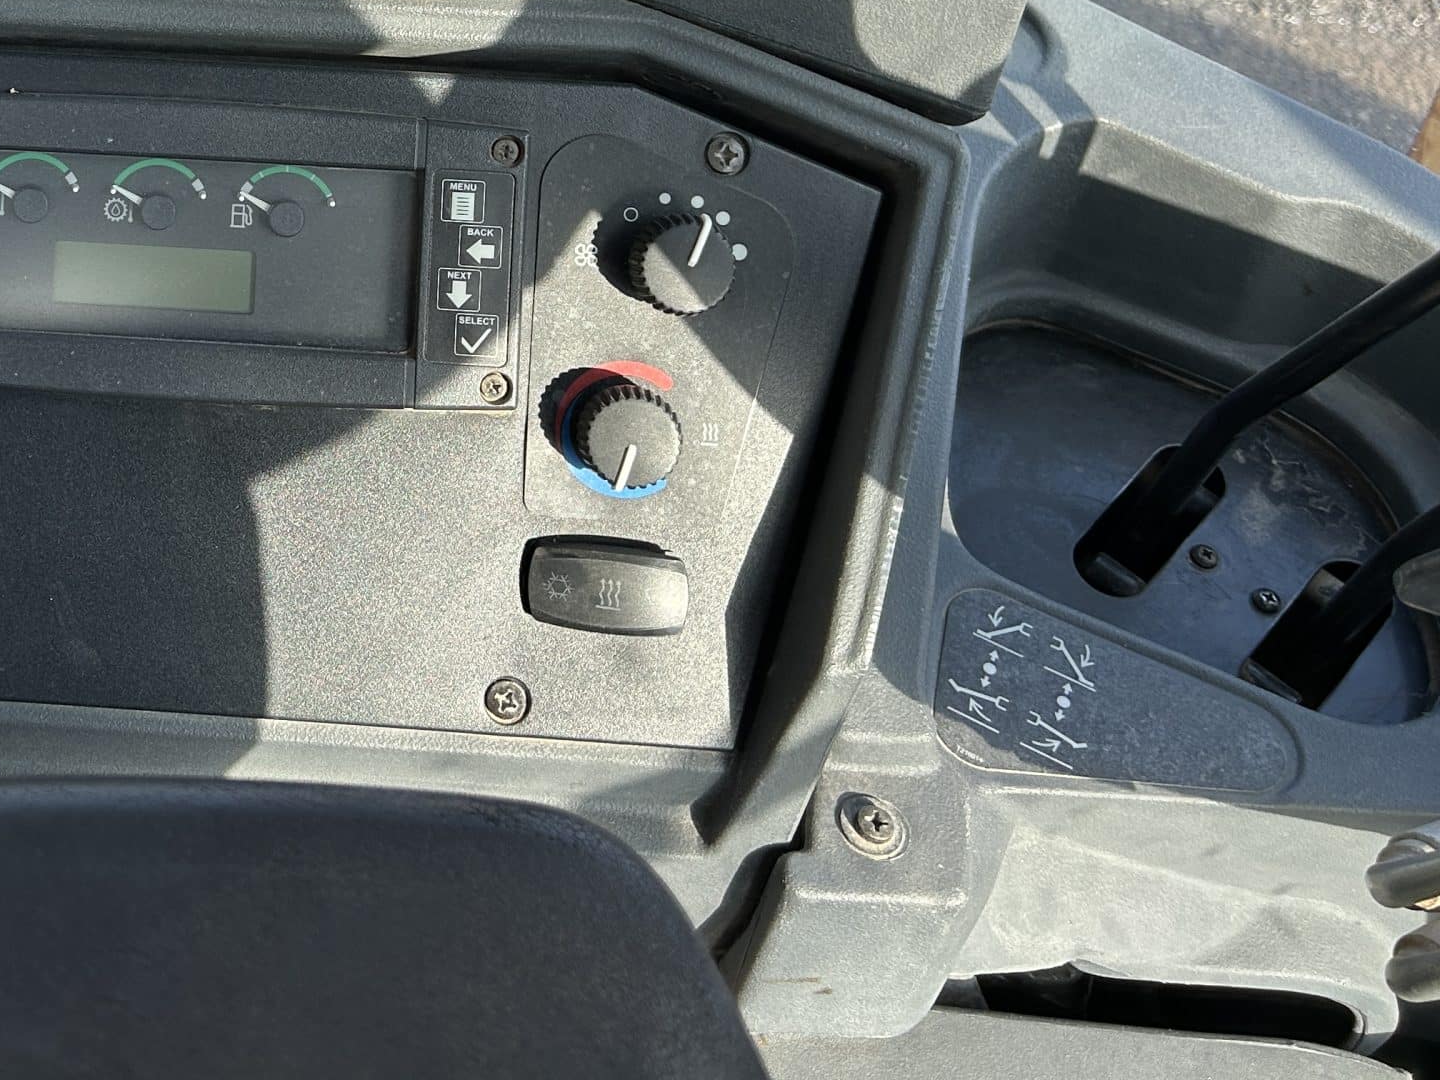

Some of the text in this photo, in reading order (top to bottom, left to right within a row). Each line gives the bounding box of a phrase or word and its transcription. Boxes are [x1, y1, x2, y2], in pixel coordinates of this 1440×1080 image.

[449, 182, 477, 192] MENU
[467, 227, 494, 237] BACK
[447, 271, 472, 280] NEXT
[458, 316, 496, 326] SELECT
